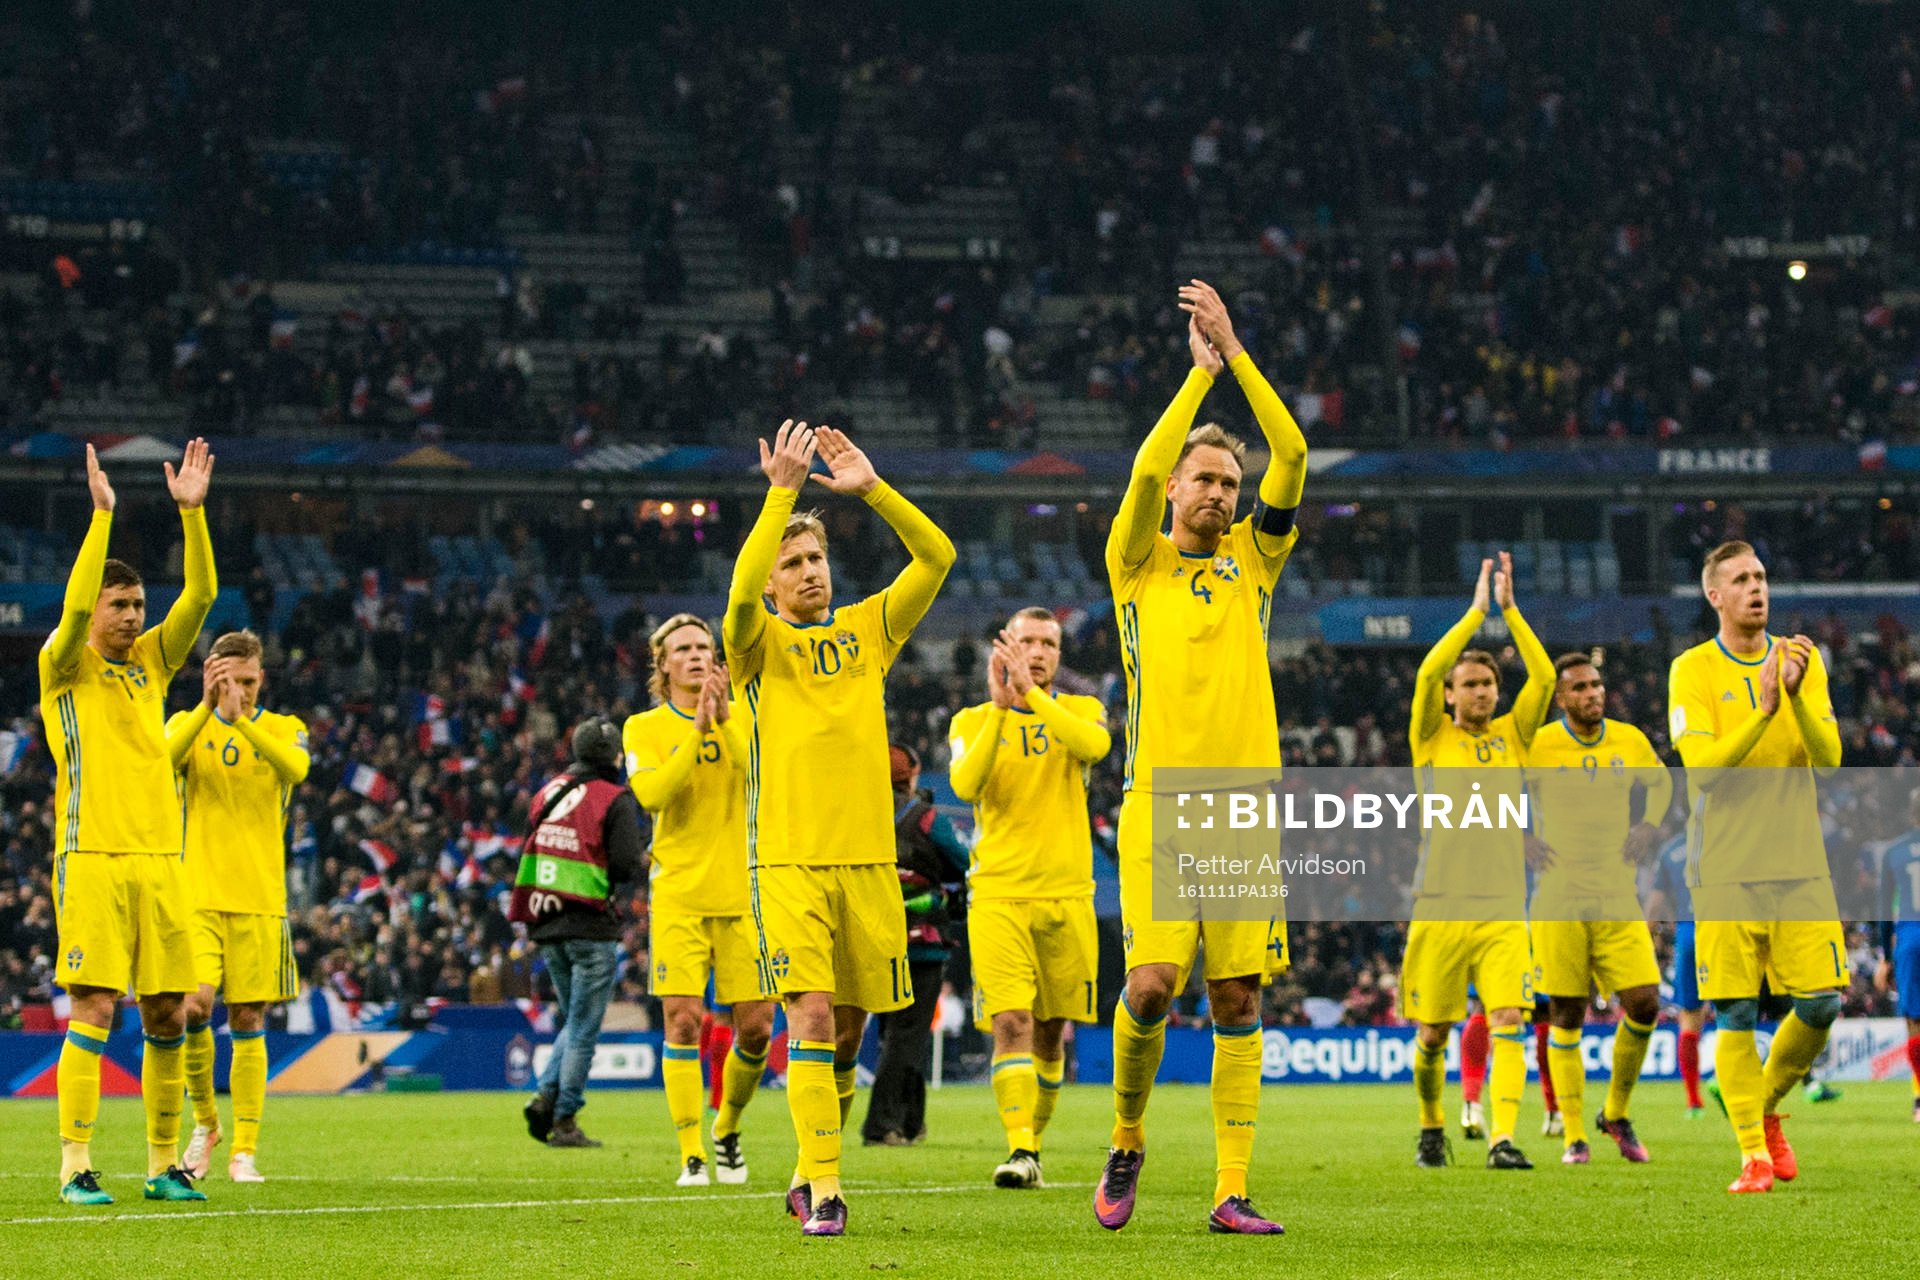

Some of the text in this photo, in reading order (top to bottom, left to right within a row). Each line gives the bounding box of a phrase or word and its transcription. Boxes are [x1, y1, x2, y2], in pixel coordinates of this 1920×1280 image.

[1659, 448, 1771, 472] FRANCE
[1191, 568, 1212, 604] 4
[810, 637, 841, 675] 10
[1744, 676, 1761, 709] 1
[222, 736, 240, 767] 6
[1019, 723, 1049, 757] 13
[1475, 740, 1492, 763] 8
[1582, 755, 1598, 782] 9
[538, 859, 557, 885] B
[1830, 940, 1843, 978] 1
